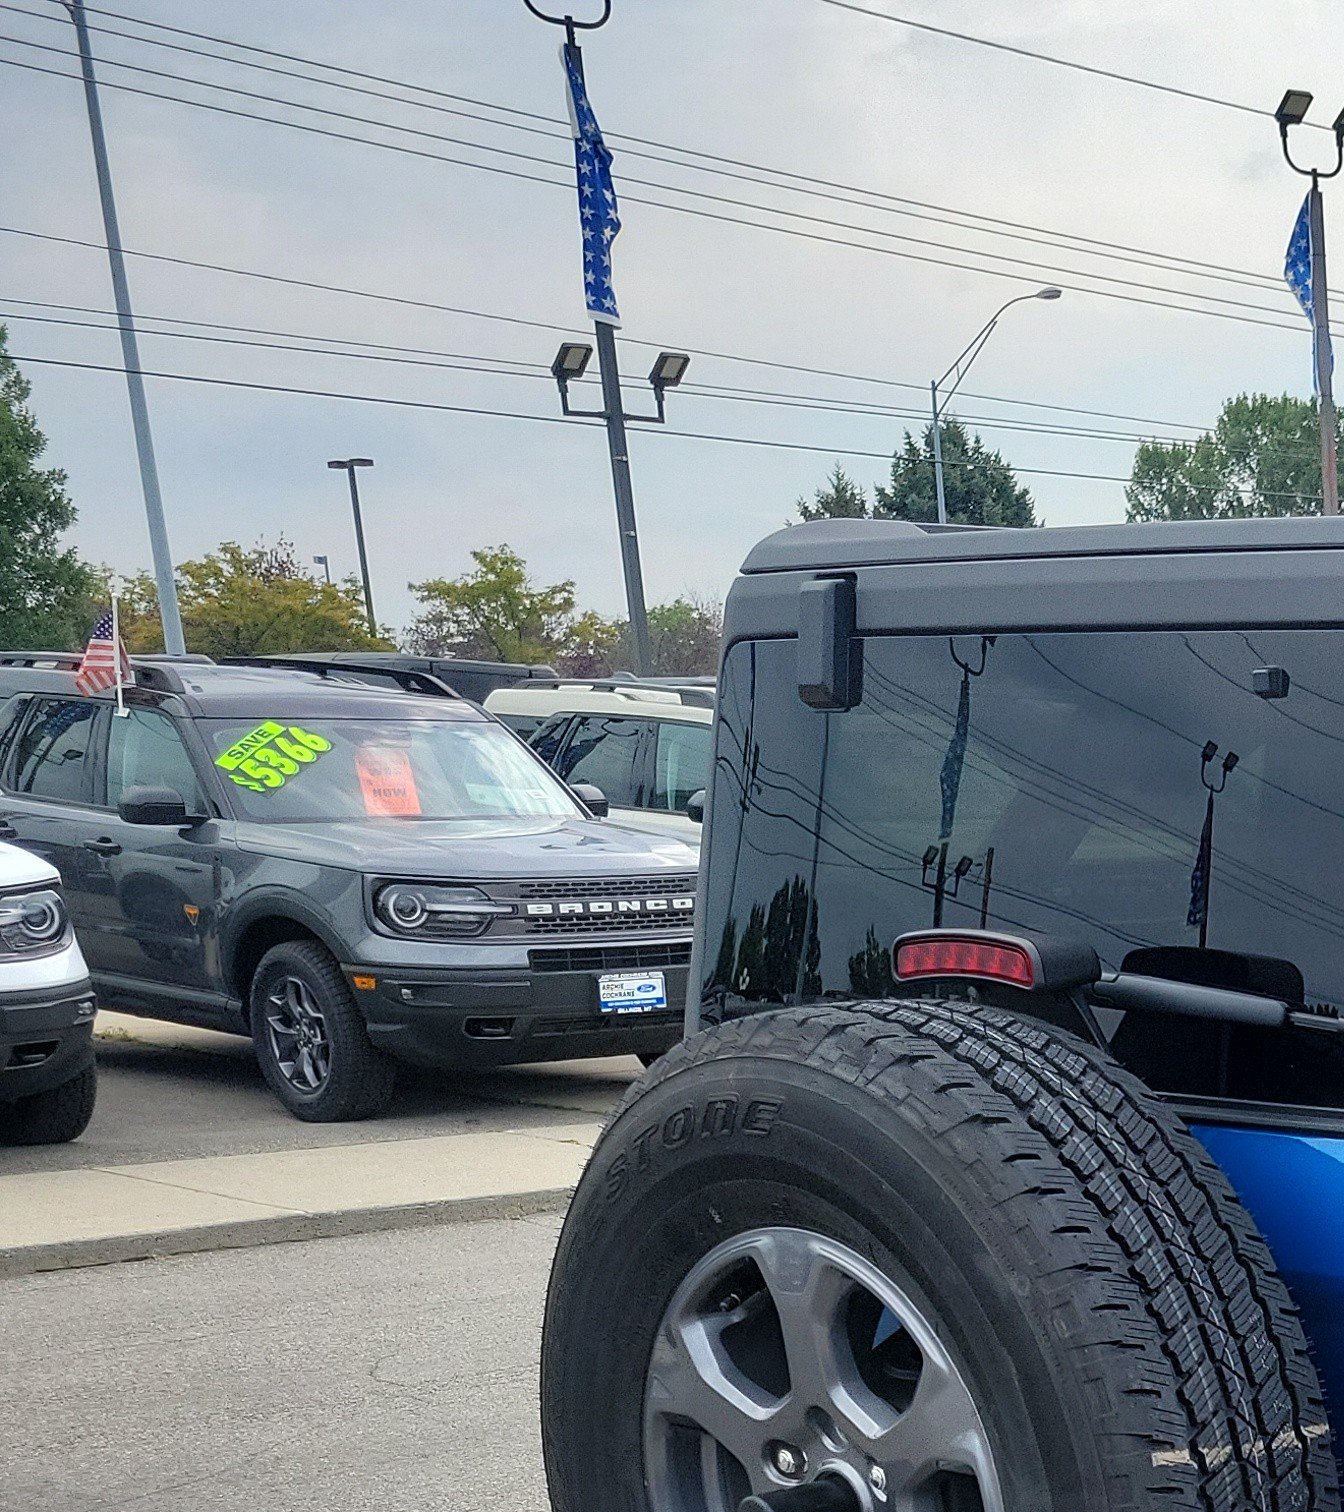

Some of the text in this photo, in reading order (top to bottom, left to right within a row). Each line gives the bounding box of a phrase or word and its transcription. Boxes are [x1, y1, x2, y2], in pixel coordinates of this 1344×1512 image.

[227, 728, 272, 760] SAVE
[228, 726, 332, 793] $5366
[526, 898, 693, 915] BRONCO
